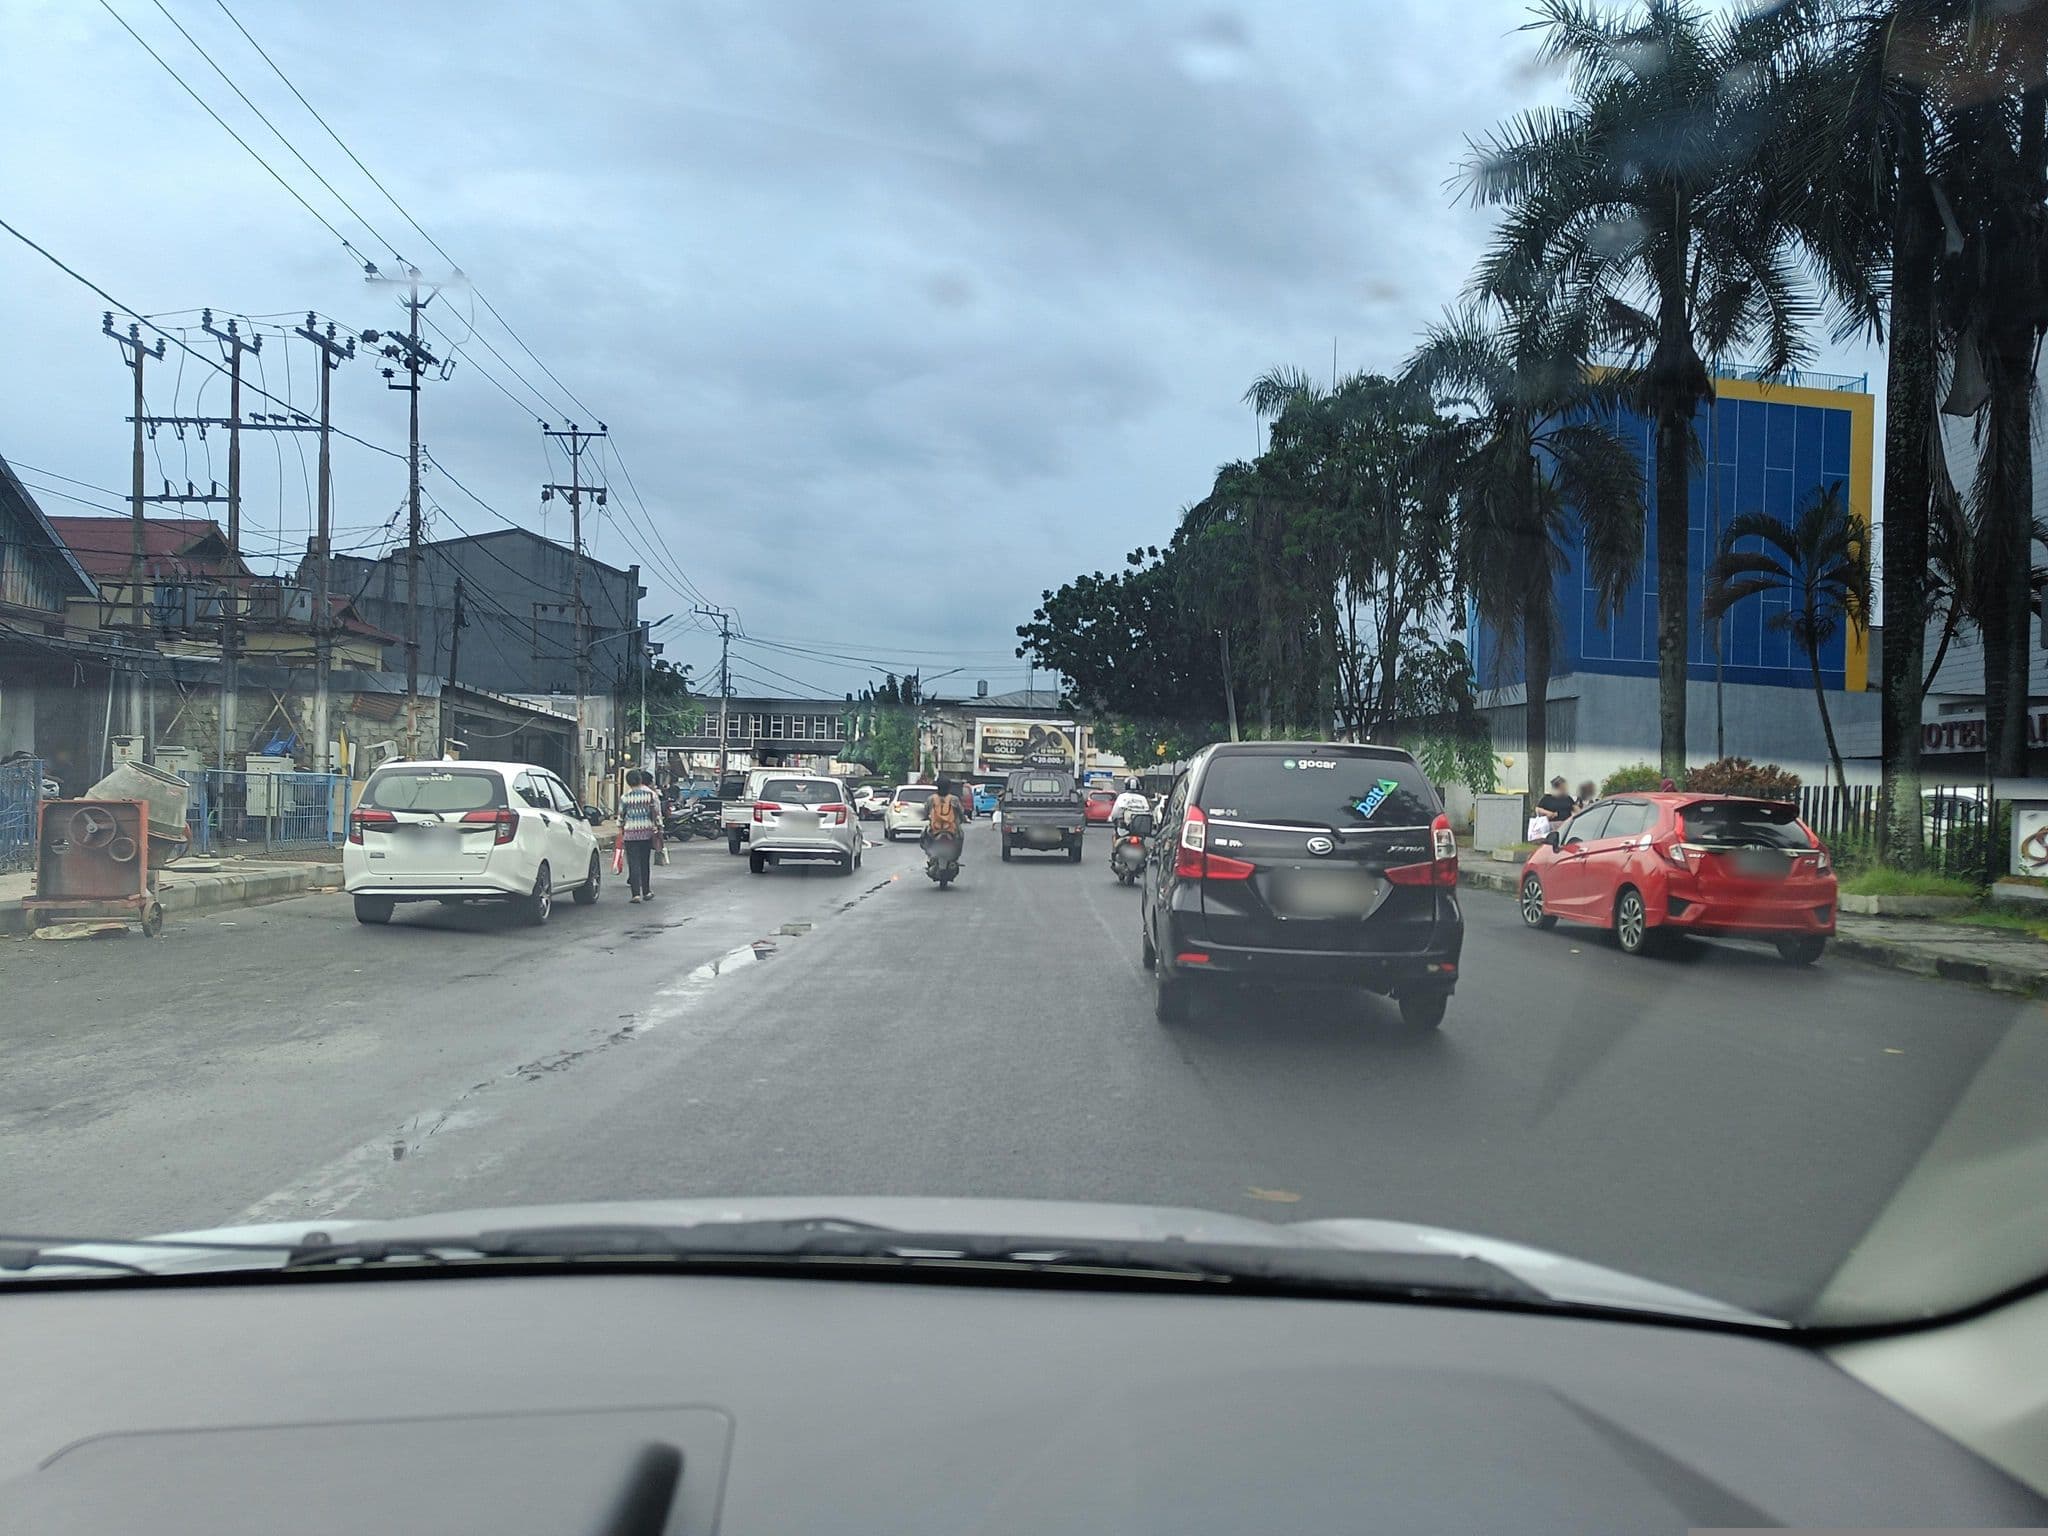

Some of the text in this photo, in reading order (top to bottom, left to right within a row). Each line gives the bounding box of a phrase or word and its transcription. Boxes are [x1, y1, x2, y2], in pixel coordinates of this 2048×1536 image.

[1921, 720, 1985, 748] OTEL
[994, 746, 1016, 754] GOLD
[1297, 759, 1337, 770] gocar
